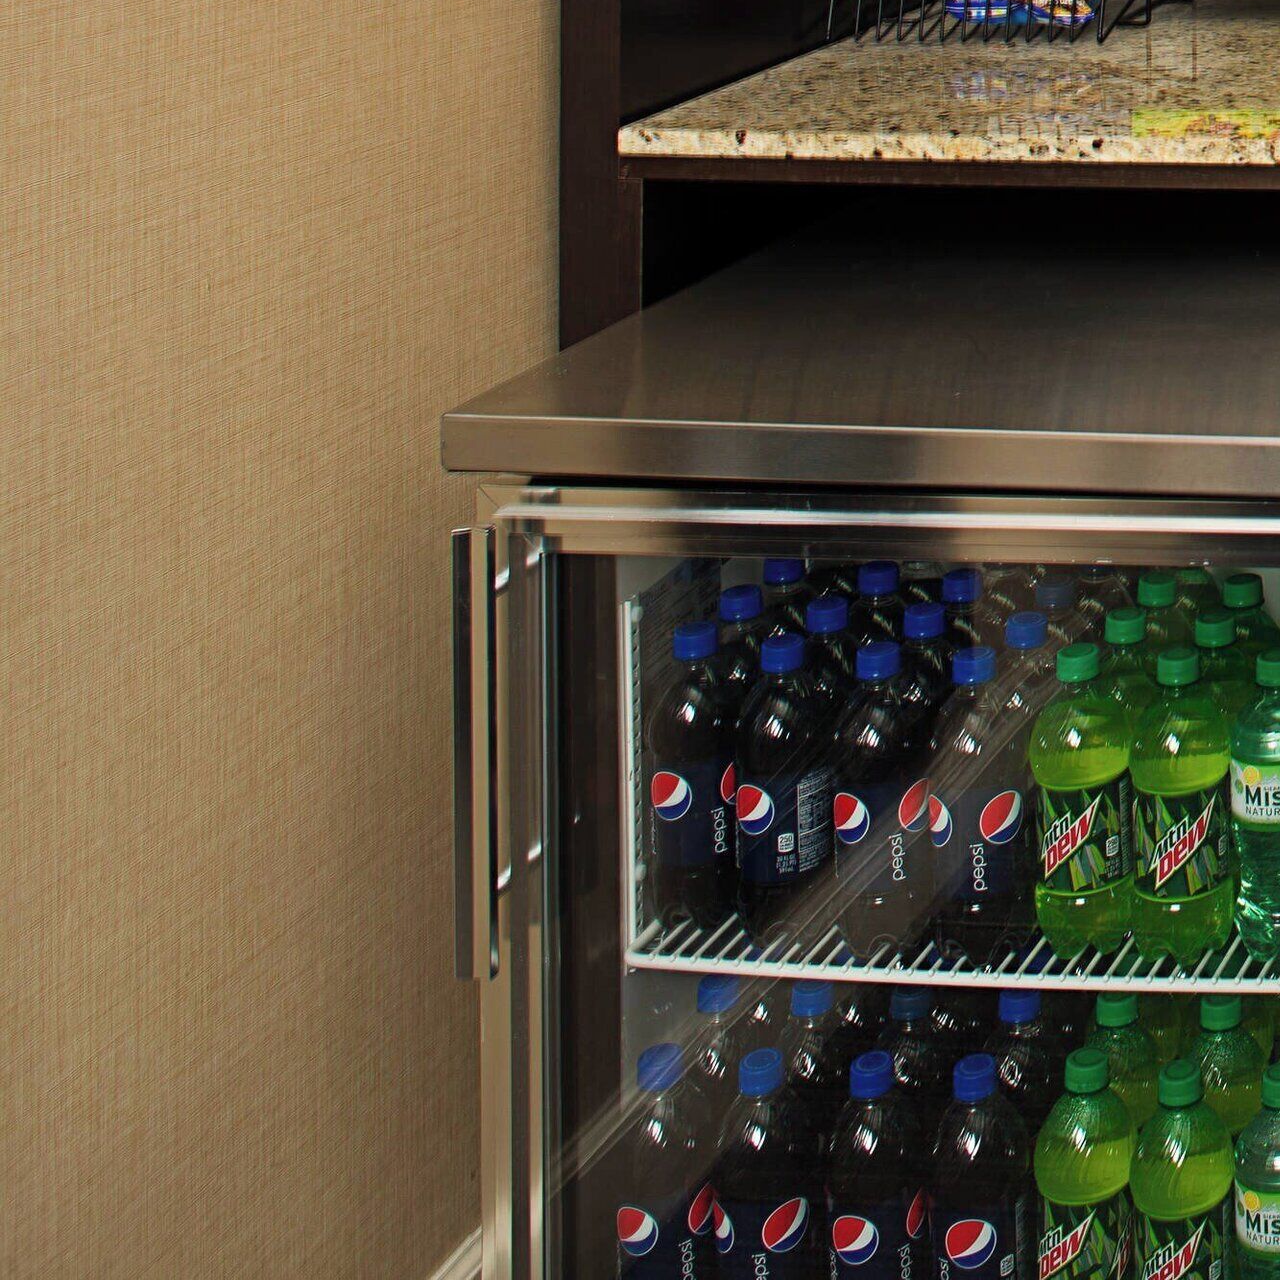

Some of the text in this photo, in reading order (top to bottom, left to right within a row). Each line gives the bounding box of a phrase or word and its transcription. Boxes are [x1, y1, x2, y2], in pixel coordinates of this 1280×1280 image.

[713, 806, 728, 854] pepsi
[889, 832, 903, 882] pepsi
[970, 842, 986, 892] pepsi
